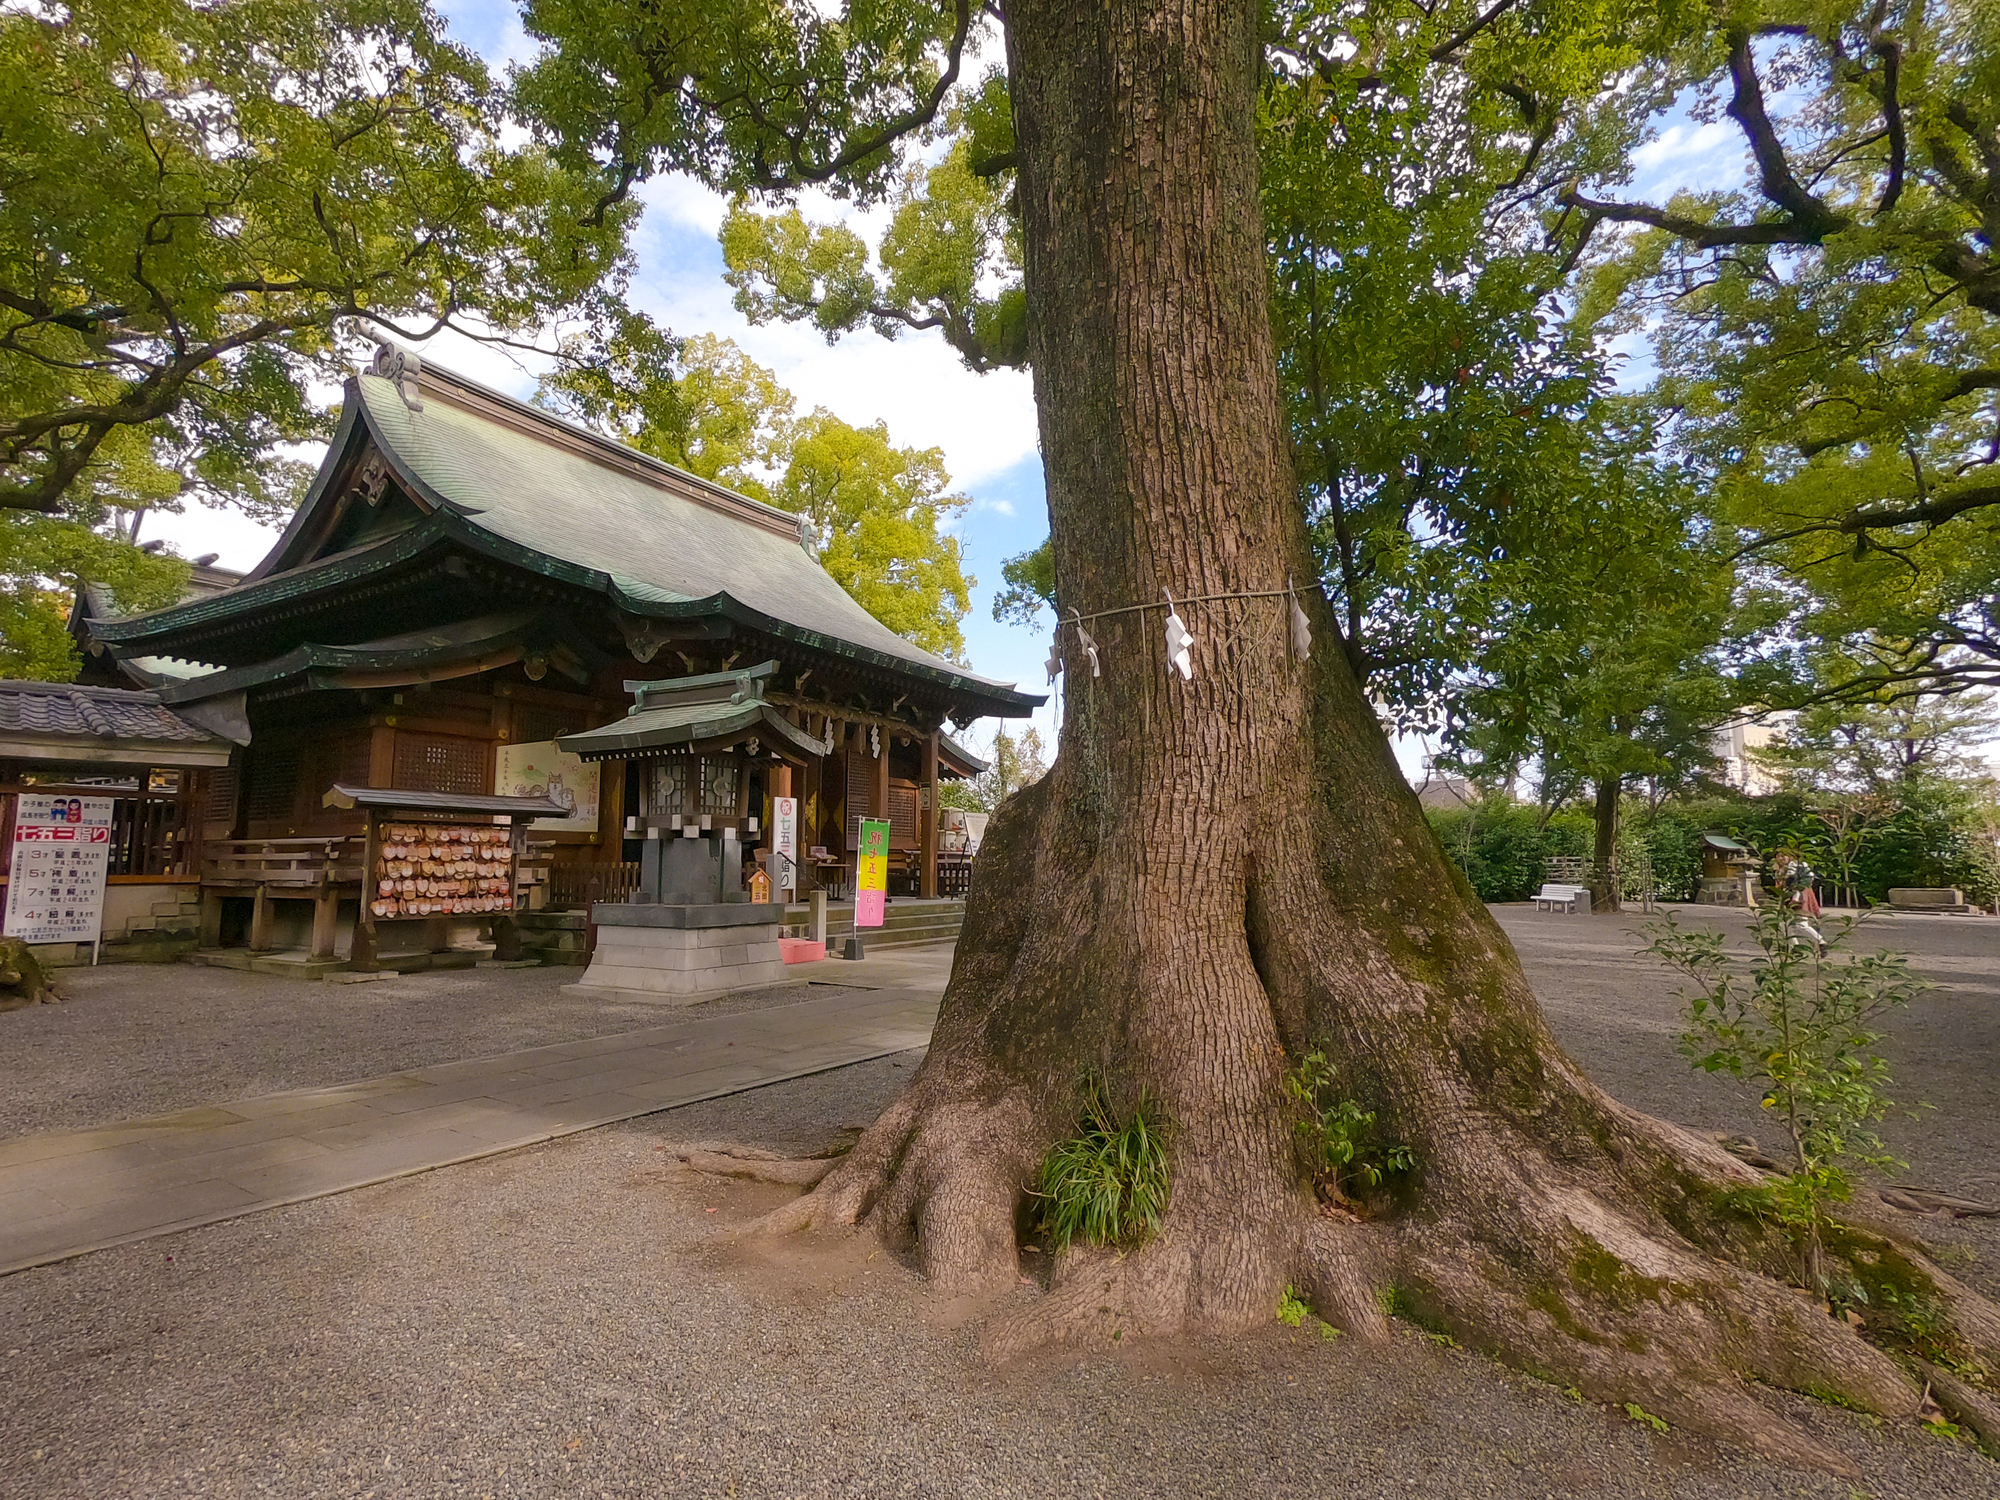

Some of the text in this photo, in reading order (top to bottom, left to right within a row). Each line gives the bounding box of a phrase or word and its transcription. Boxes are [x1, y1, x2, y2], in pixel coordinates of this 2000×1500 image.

[17, 826, 108, 843] 七五三詣り
